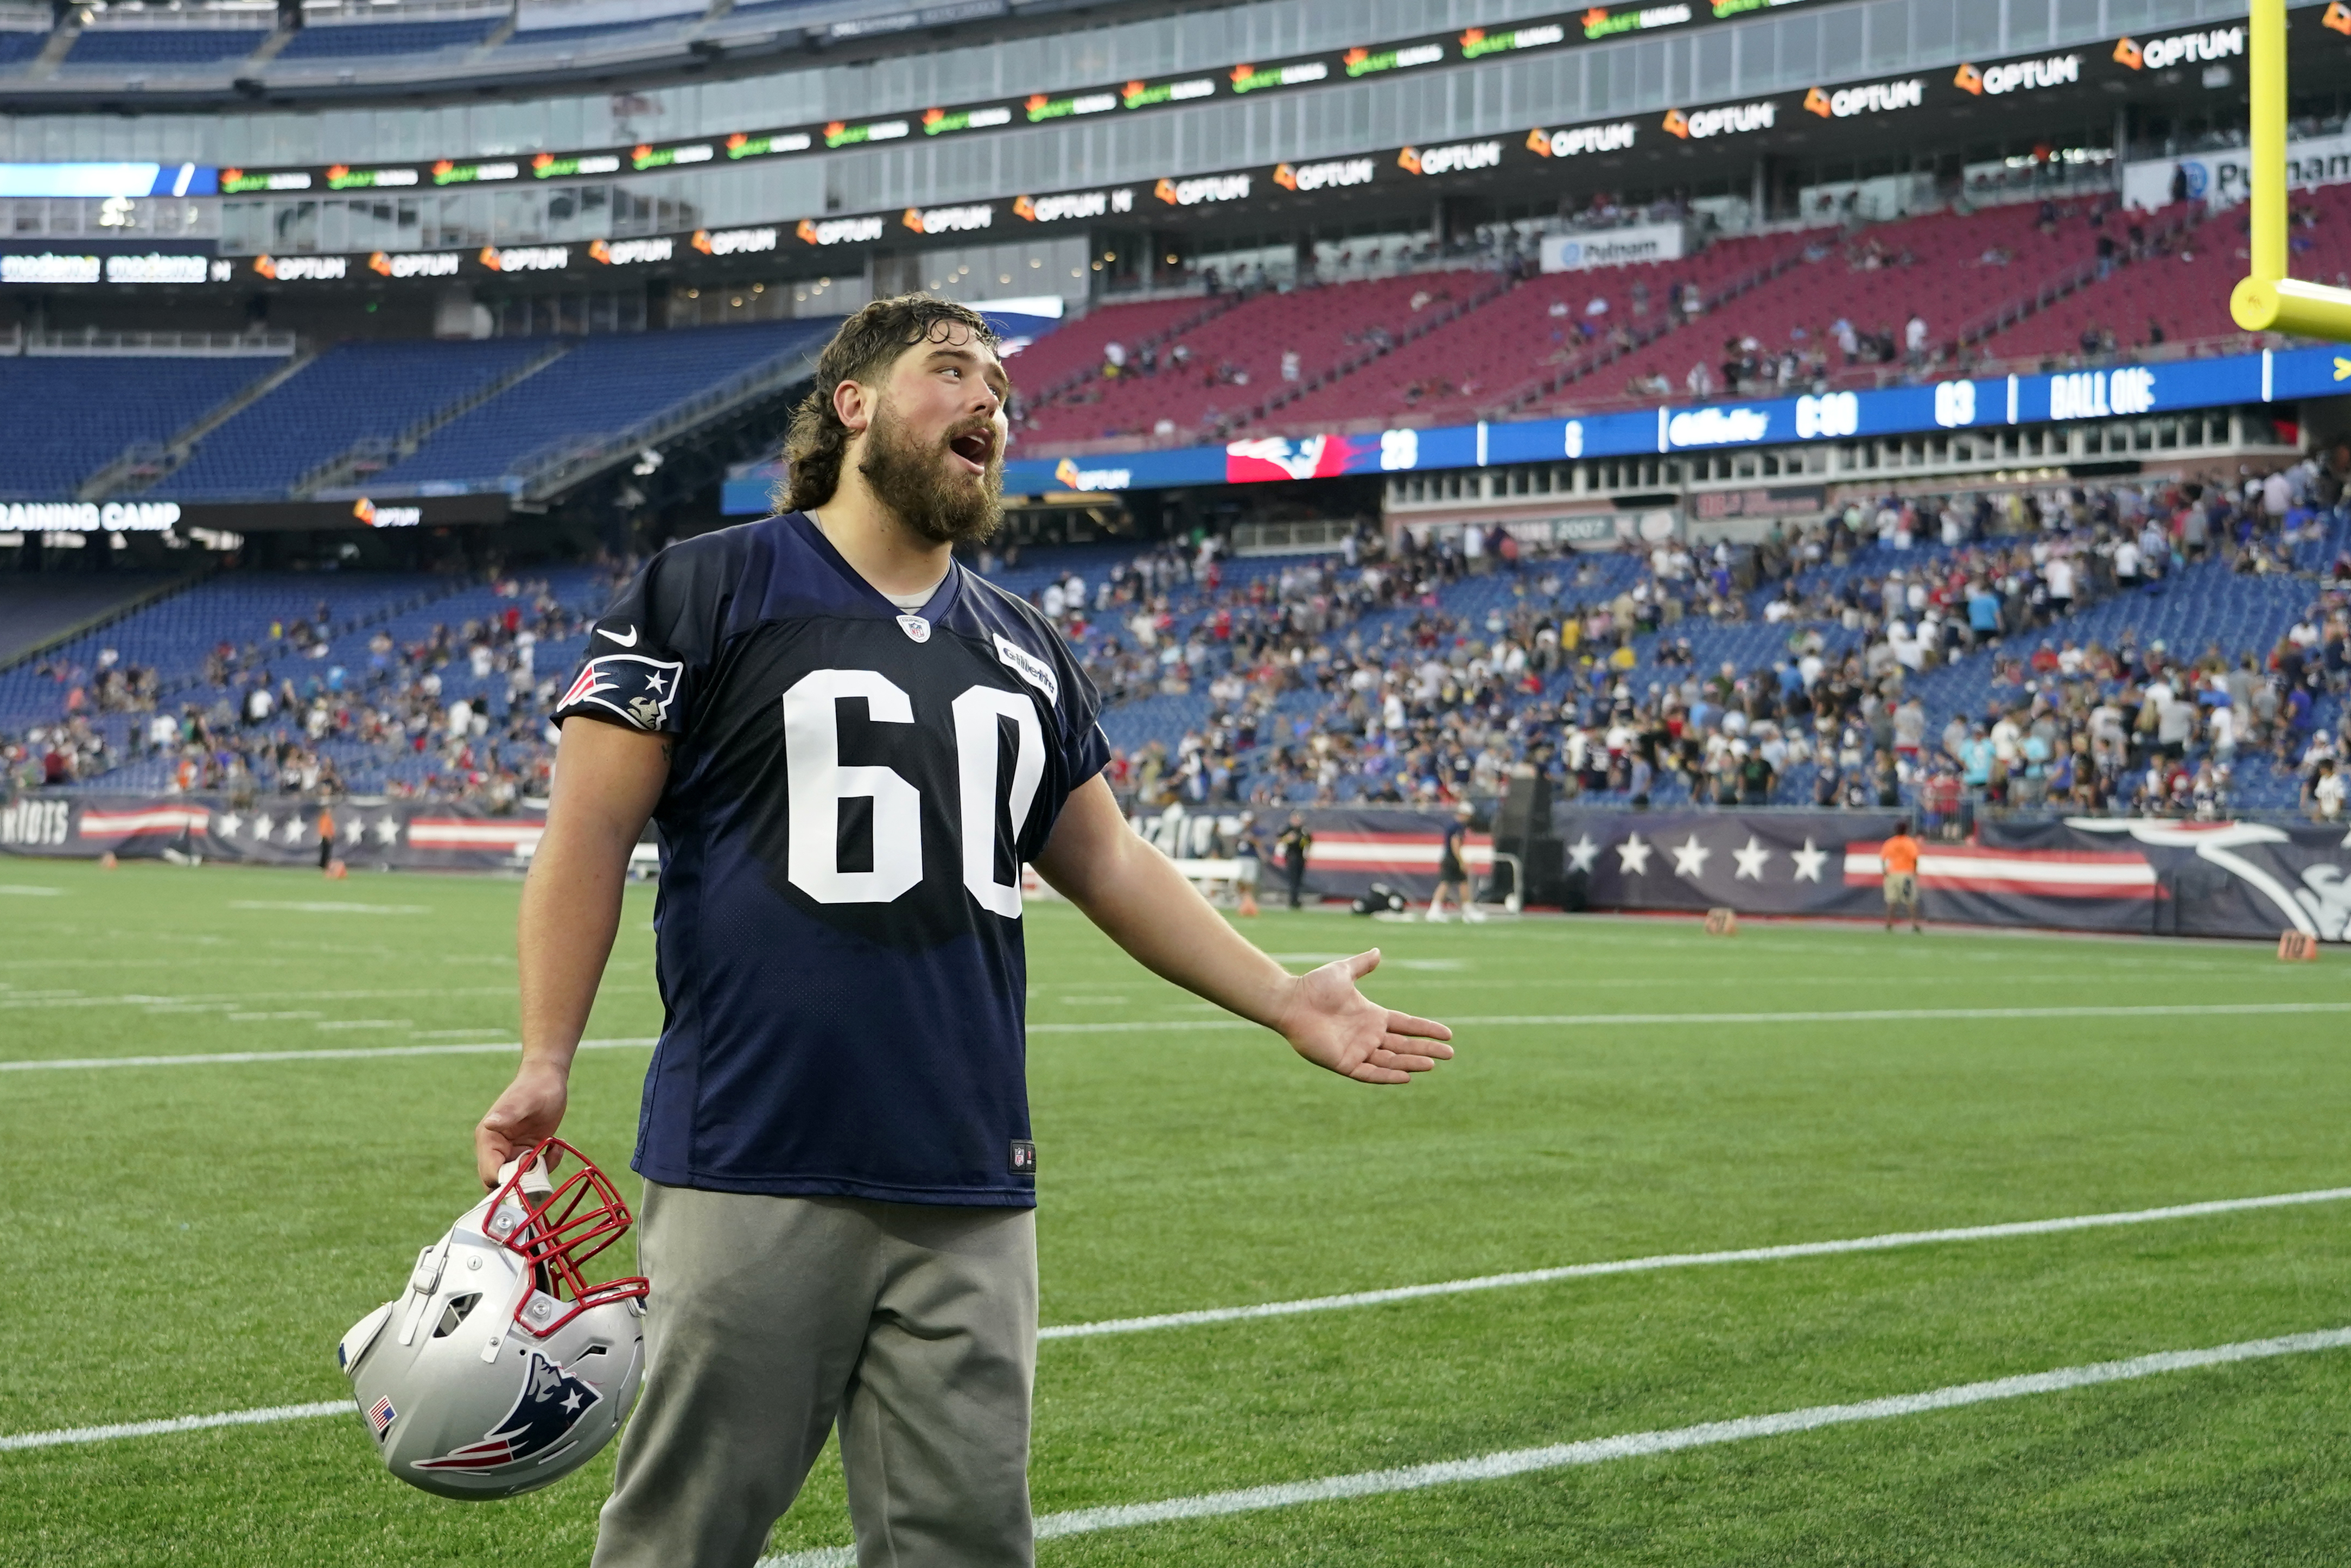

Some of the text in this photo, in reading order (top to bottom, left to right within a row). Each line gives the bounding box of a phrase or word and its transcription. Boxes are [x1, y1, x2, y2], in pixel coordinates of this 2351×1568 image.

[2050, 371, 2111, 420] BALL
[100, 502, 181, 531] CAMP
[783, 668, 1046, 919] 60
